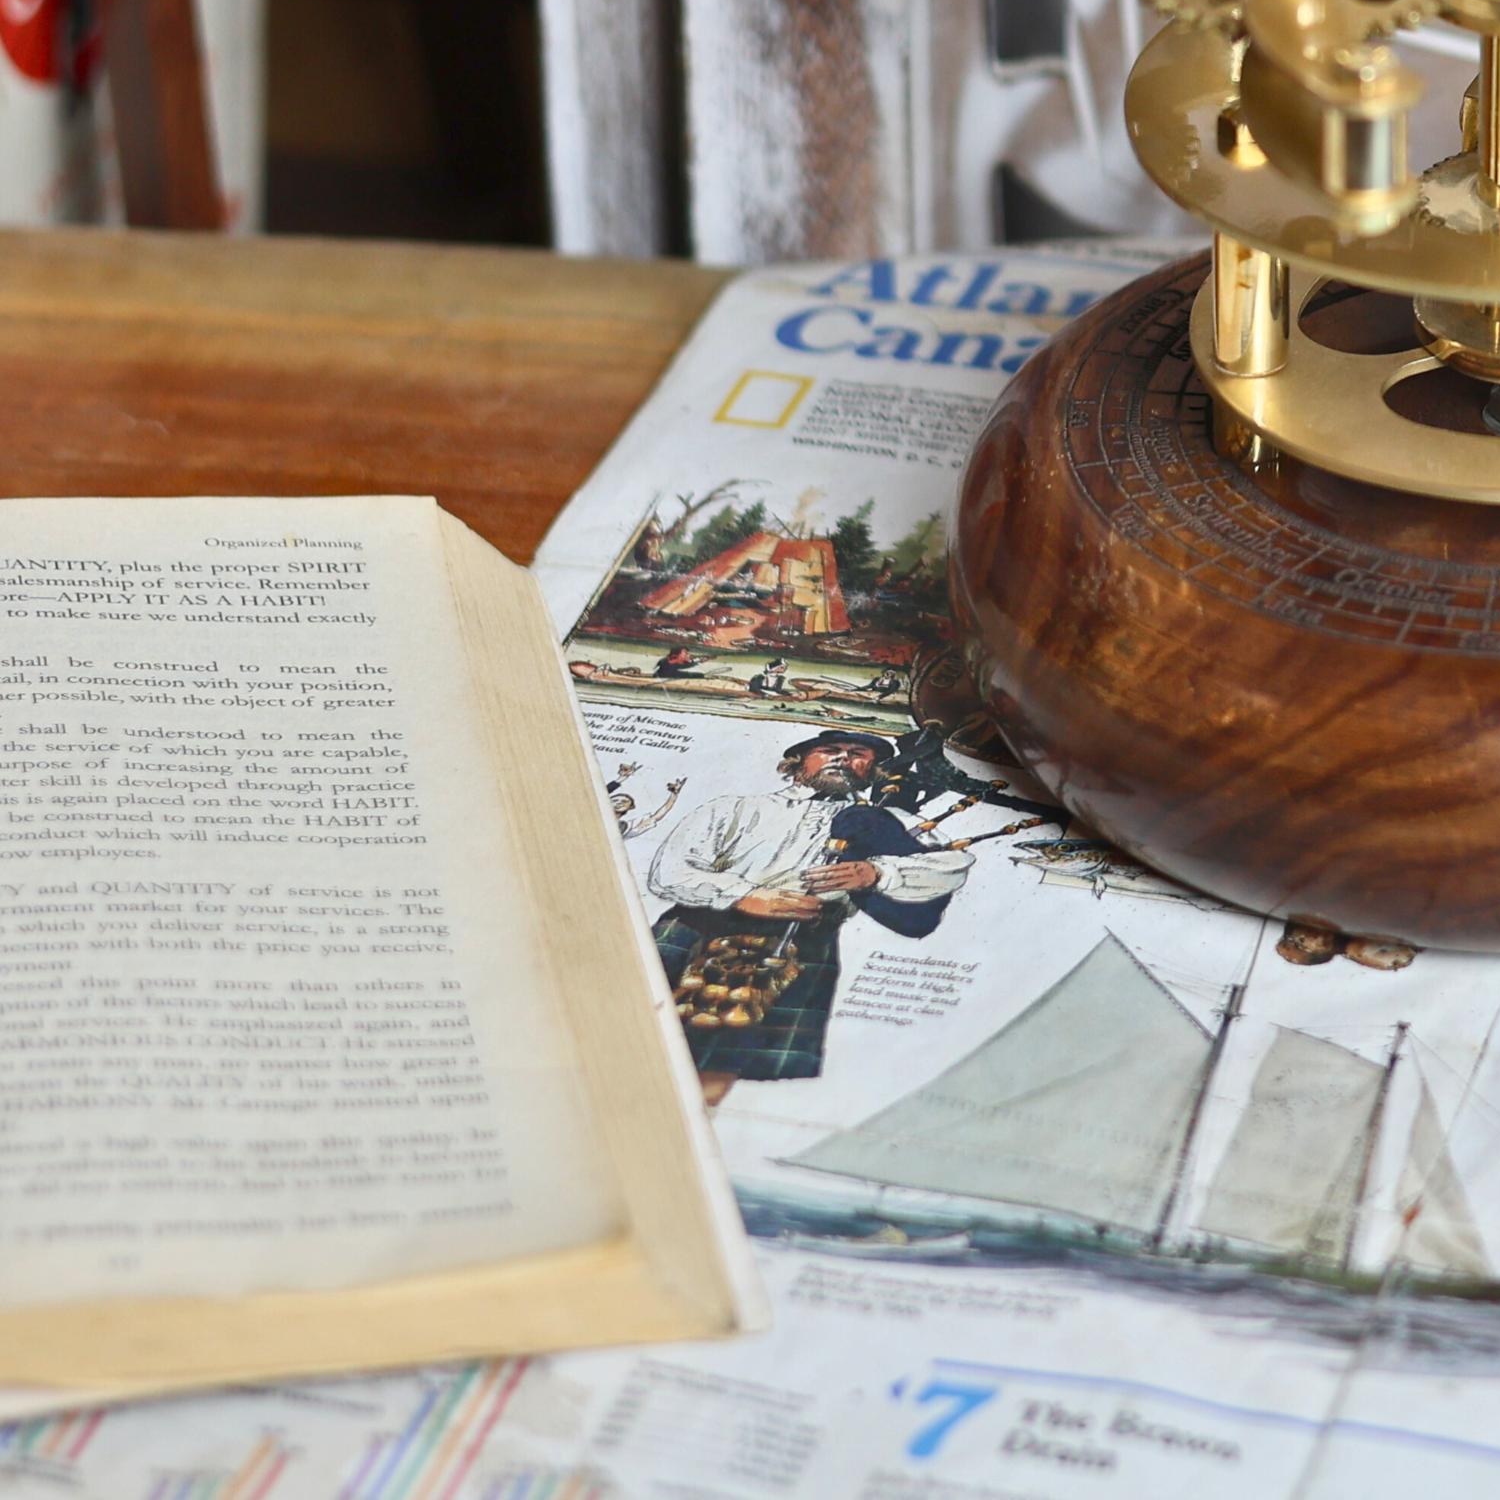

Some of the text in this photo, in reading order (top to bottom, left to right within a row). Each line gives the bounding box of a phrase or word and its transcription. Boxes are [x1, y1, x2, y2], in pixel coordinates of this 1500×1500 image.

[204, 538, 363, 550] Organized Planning
[120, 561, 366, 576] plus the proper SPIRIT
[141, 578, 370, 590] of service. Remember
[1334, 567, 1456, 603] October
[145, 594, 170, 605] IT
[178, 595, 208, 605] AS
[216, 595, 233, 606] A
[36, 608, 91, 619] make
[98, 612, 142, 620] sure
[148, 613, 177, 621] we
[184, 612, 300, 623] understand
[307, 612, 376, 627] exactly
[1, 656, 388, 674] shall be construed to mean the
[66, 676, 185, 688] connection
[192, 678, 238, 689] with
[246, 682, 293, 692] your
[300, 683, 392, 694] position,
[616, 714, 687, 730] of Micmac
[607, 724, 695, 742] 19th century.
[639, 738, 690, 753] Gallery
[117, 775, 416, 795] developed through practice
[332, 797, 419, 809] HABIT.
[91, 881, 236, 898] QUANTITY
[868, 951, 981, 973] Descendants of
[863, 962, 974, 984] Scottish settlers
